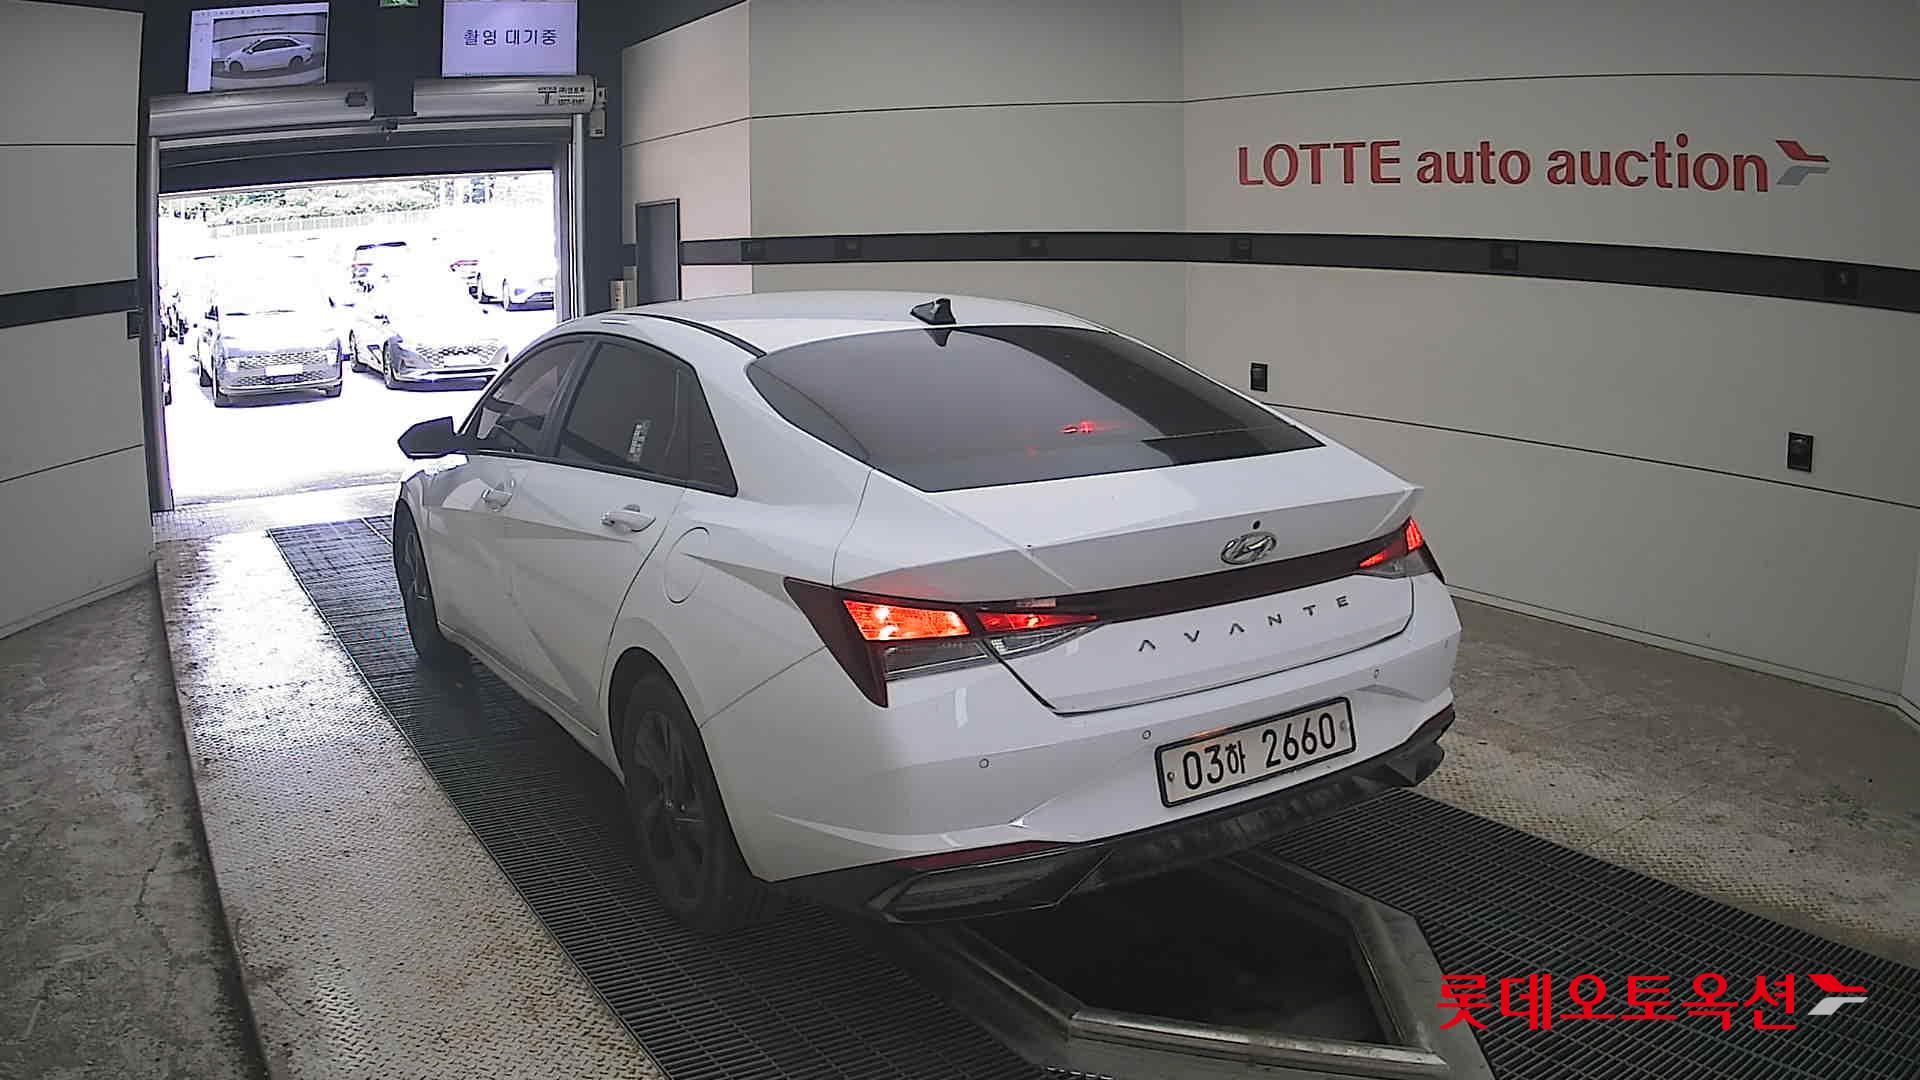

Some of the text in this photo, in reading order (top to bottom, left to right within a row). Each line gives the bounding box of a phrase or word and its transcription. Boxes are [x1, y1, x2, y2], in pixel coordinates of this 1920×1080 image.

[464, 29, 558, 46] 촬영 대기중
[1239, 133, 1768, 192] LOTTE auto auction
[1138, 596, 1349, 652] AVANTE
[1182, 712, 1336, 790] 03하 2660
